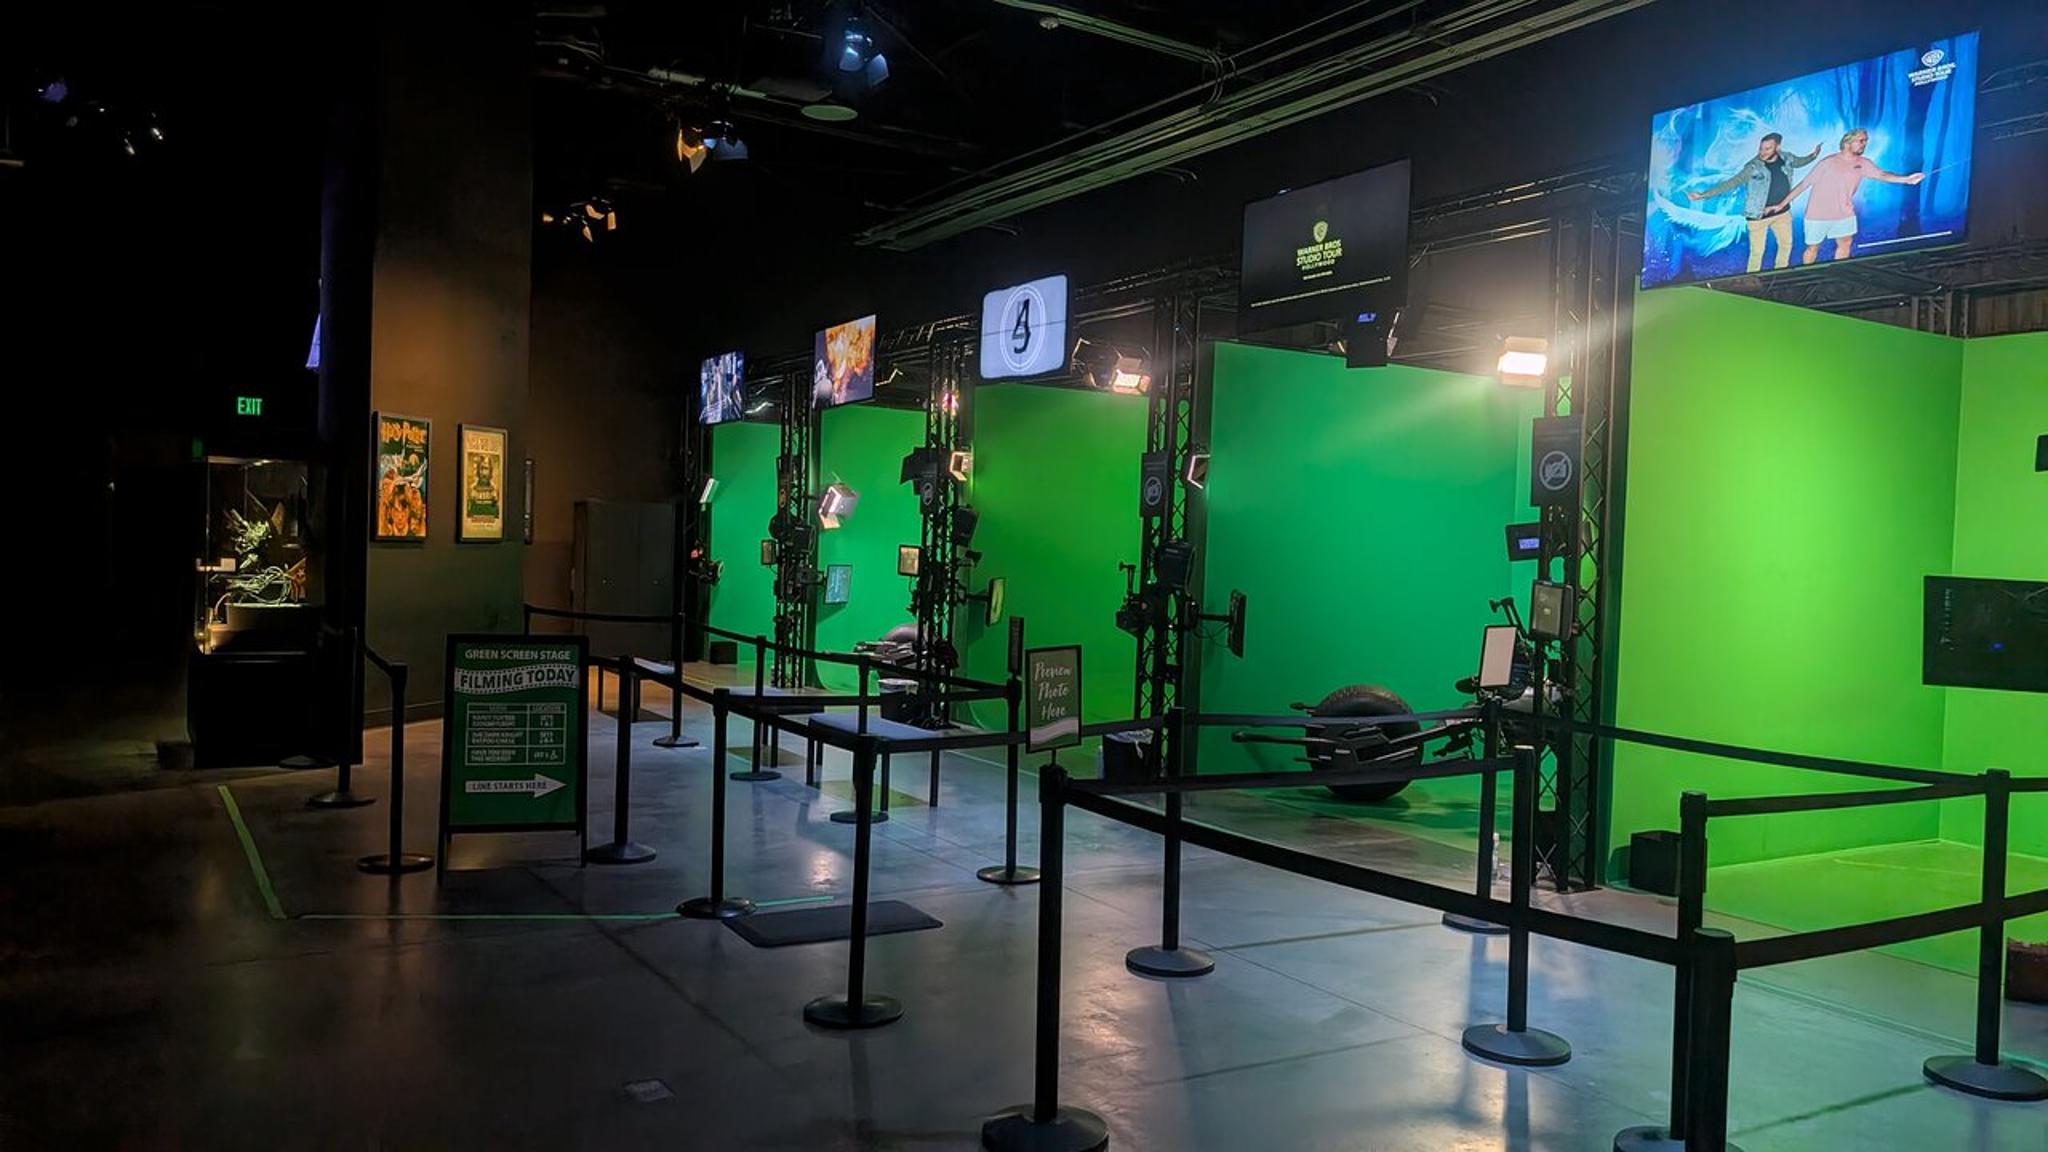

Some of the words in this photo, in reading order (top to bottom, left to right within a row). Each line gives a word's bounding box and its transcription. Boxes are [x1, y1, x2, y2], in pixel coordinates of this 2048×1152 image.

[1296, 252, 1322, 266] STUDIO
[1323, 248, 1343, 260] TOUR
[1297, 244, 1323, 257] WARNER
[1302, 259, 1335, 270] HOLLYWOOD
[237, 396, 264, 416] EXIT
[464, 649, 498, 660] GREEN
[500, 649, 538, 660] SCREEN
[539, 650, 571, 660] STAGE
[460, 672, 523, 689] FILMING
[526, 668, 576, 683] TODAY
[1038, 681, 1070, 702] Photo
[1041, 703, 1066, 721] Here
[472, 781, 492, 790] LINE
[494, 781, 524, 790] STARTS
[526, 780, 547, 790] HERE
